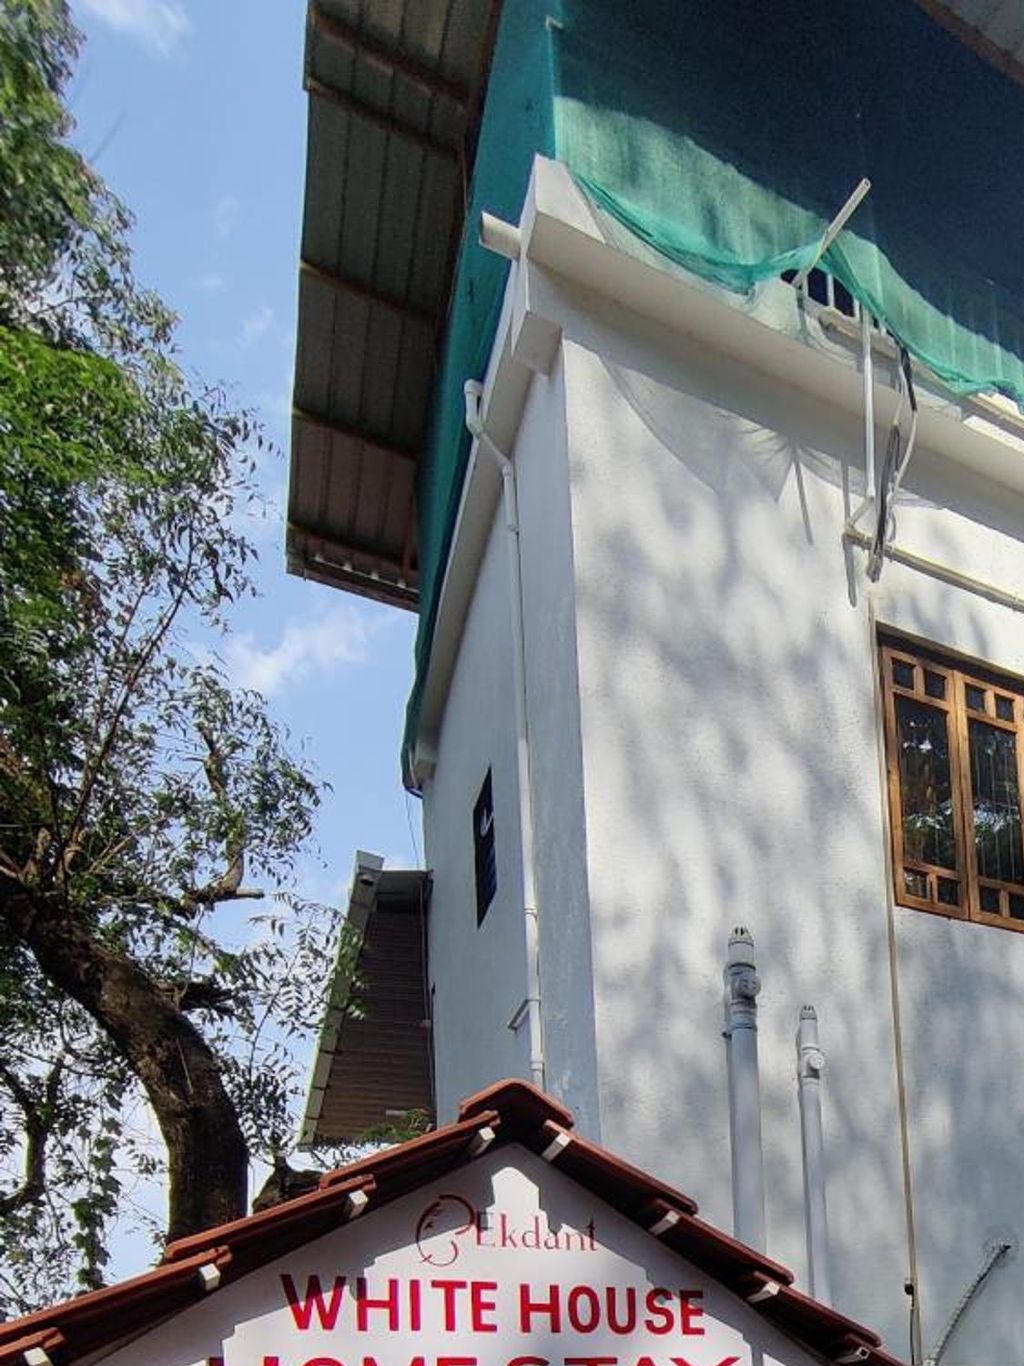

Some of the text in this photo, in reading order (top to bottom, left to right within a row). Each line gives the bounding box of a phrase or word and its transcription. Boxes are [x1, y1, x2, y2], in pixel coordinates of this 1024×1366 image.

[476, 1211, 598, 1251] Ekdant
[281, 1274, 706, 1337] WHITE HOUSE
